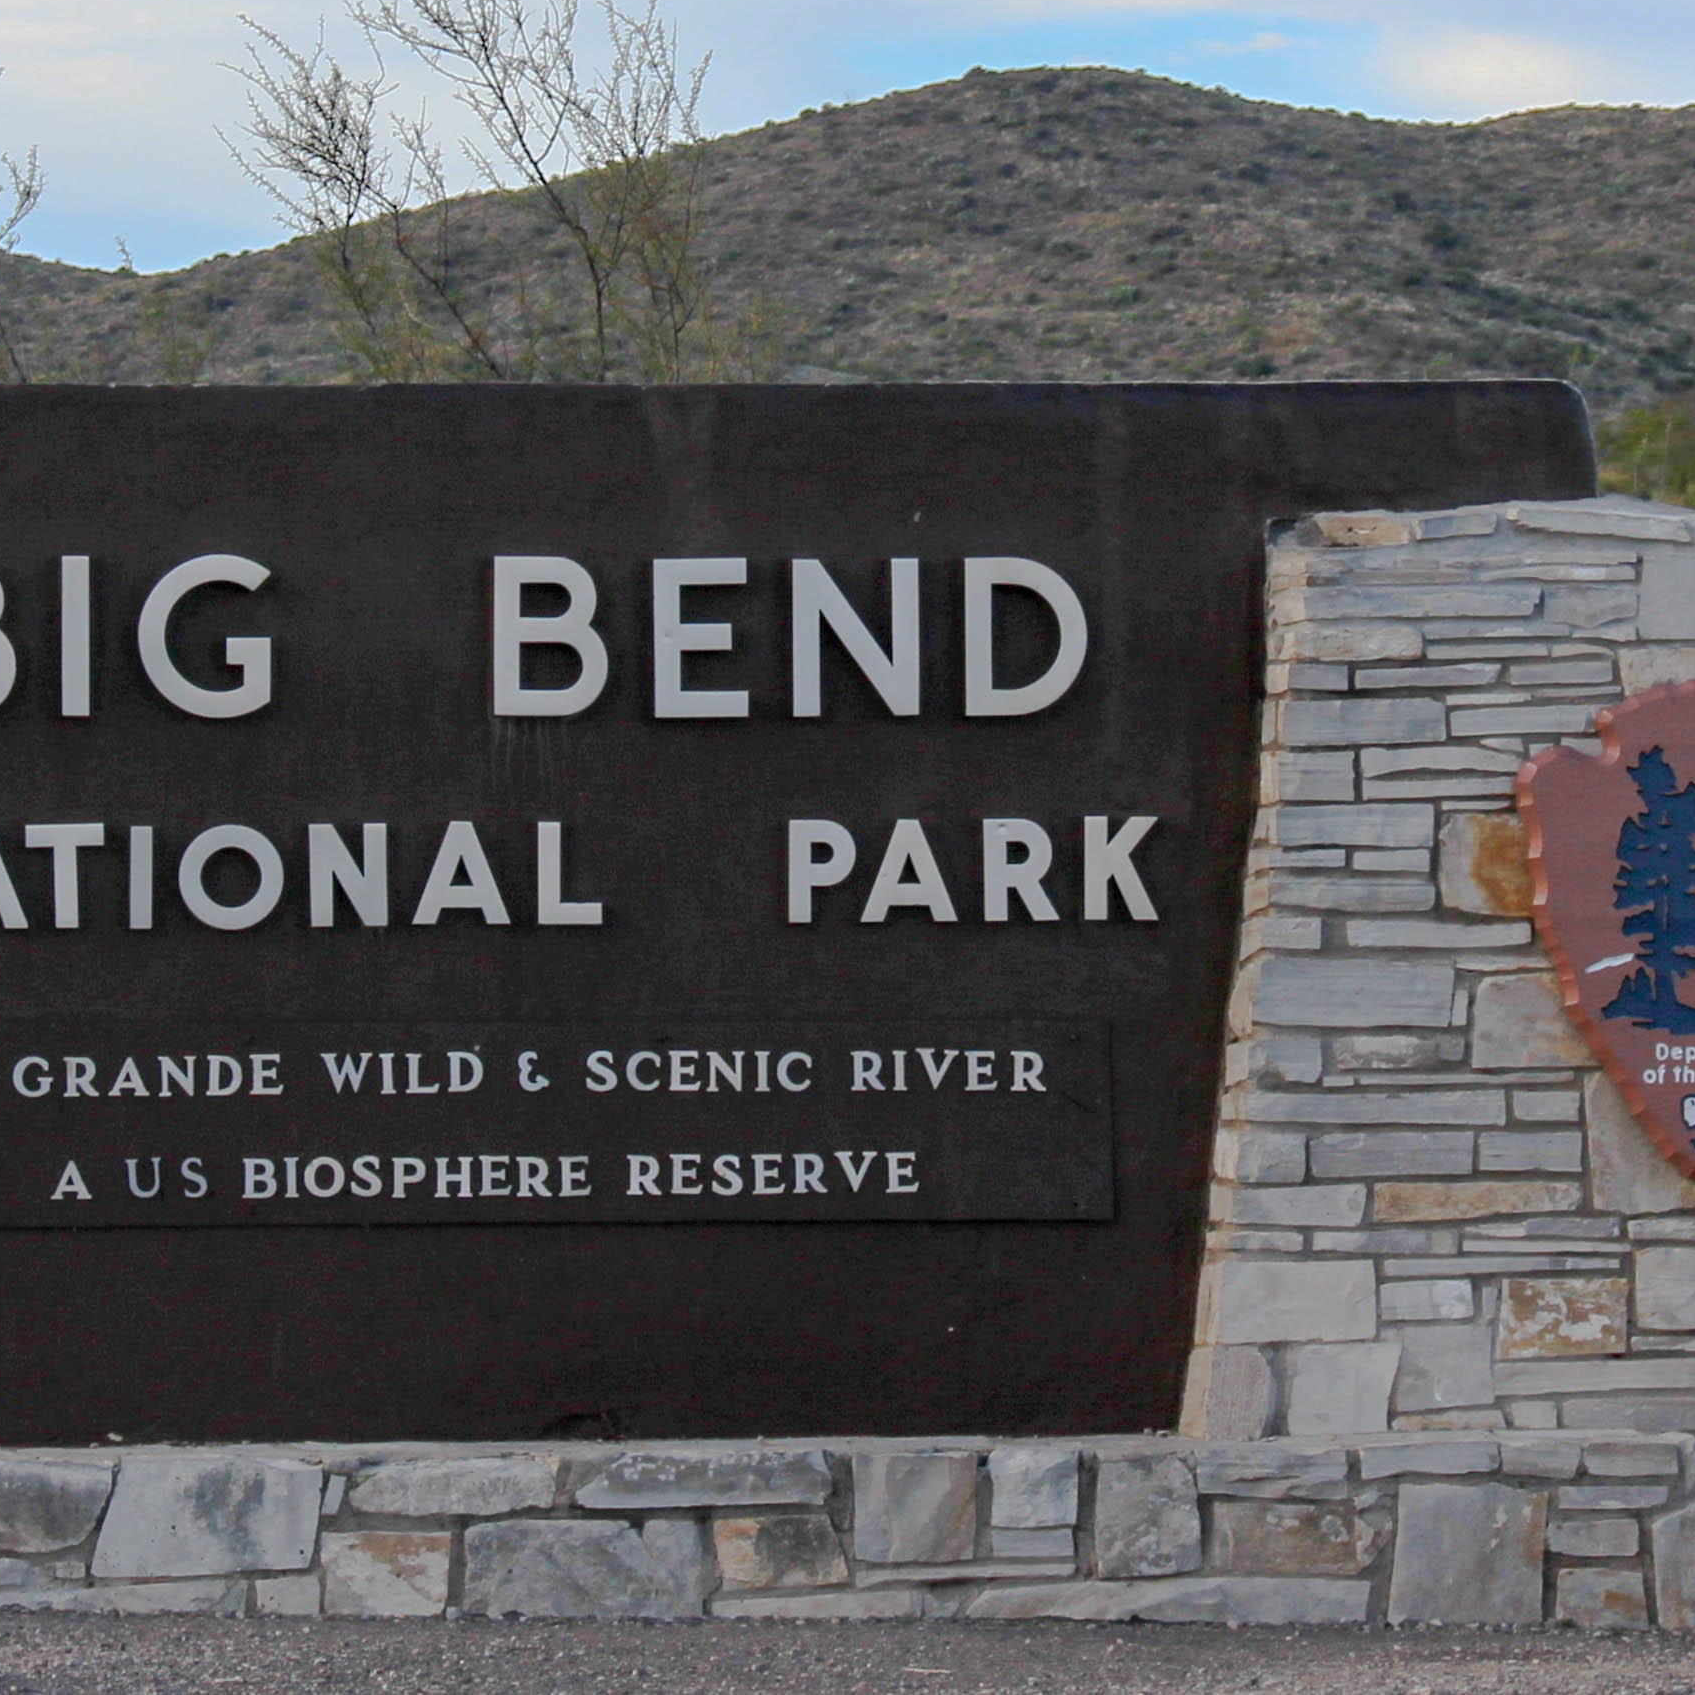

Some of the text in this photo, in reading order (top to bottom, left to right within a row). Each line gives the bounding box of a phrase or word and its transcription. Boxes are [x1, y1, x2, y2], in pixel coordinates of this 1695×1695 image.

[492, 555, 1089, 719] BEND
[787, 814, 1160, 925] PARK
[11, 1053, 285, 1099] GRANDE
[319, 1051, 485, 1096] WILD
[516, 1050, 551, 1093] &
[584, 1050, 813, 1093] SCENIC
[849, 1046, 1049, 1093] RIVER
[1642, 1064, 1667, 1085] of
[49, 1159, 94, 1201] A
[241, 1154, 593, 1200] BIOSPHERE
[625, 1149, 921, 1197] RESERVE
